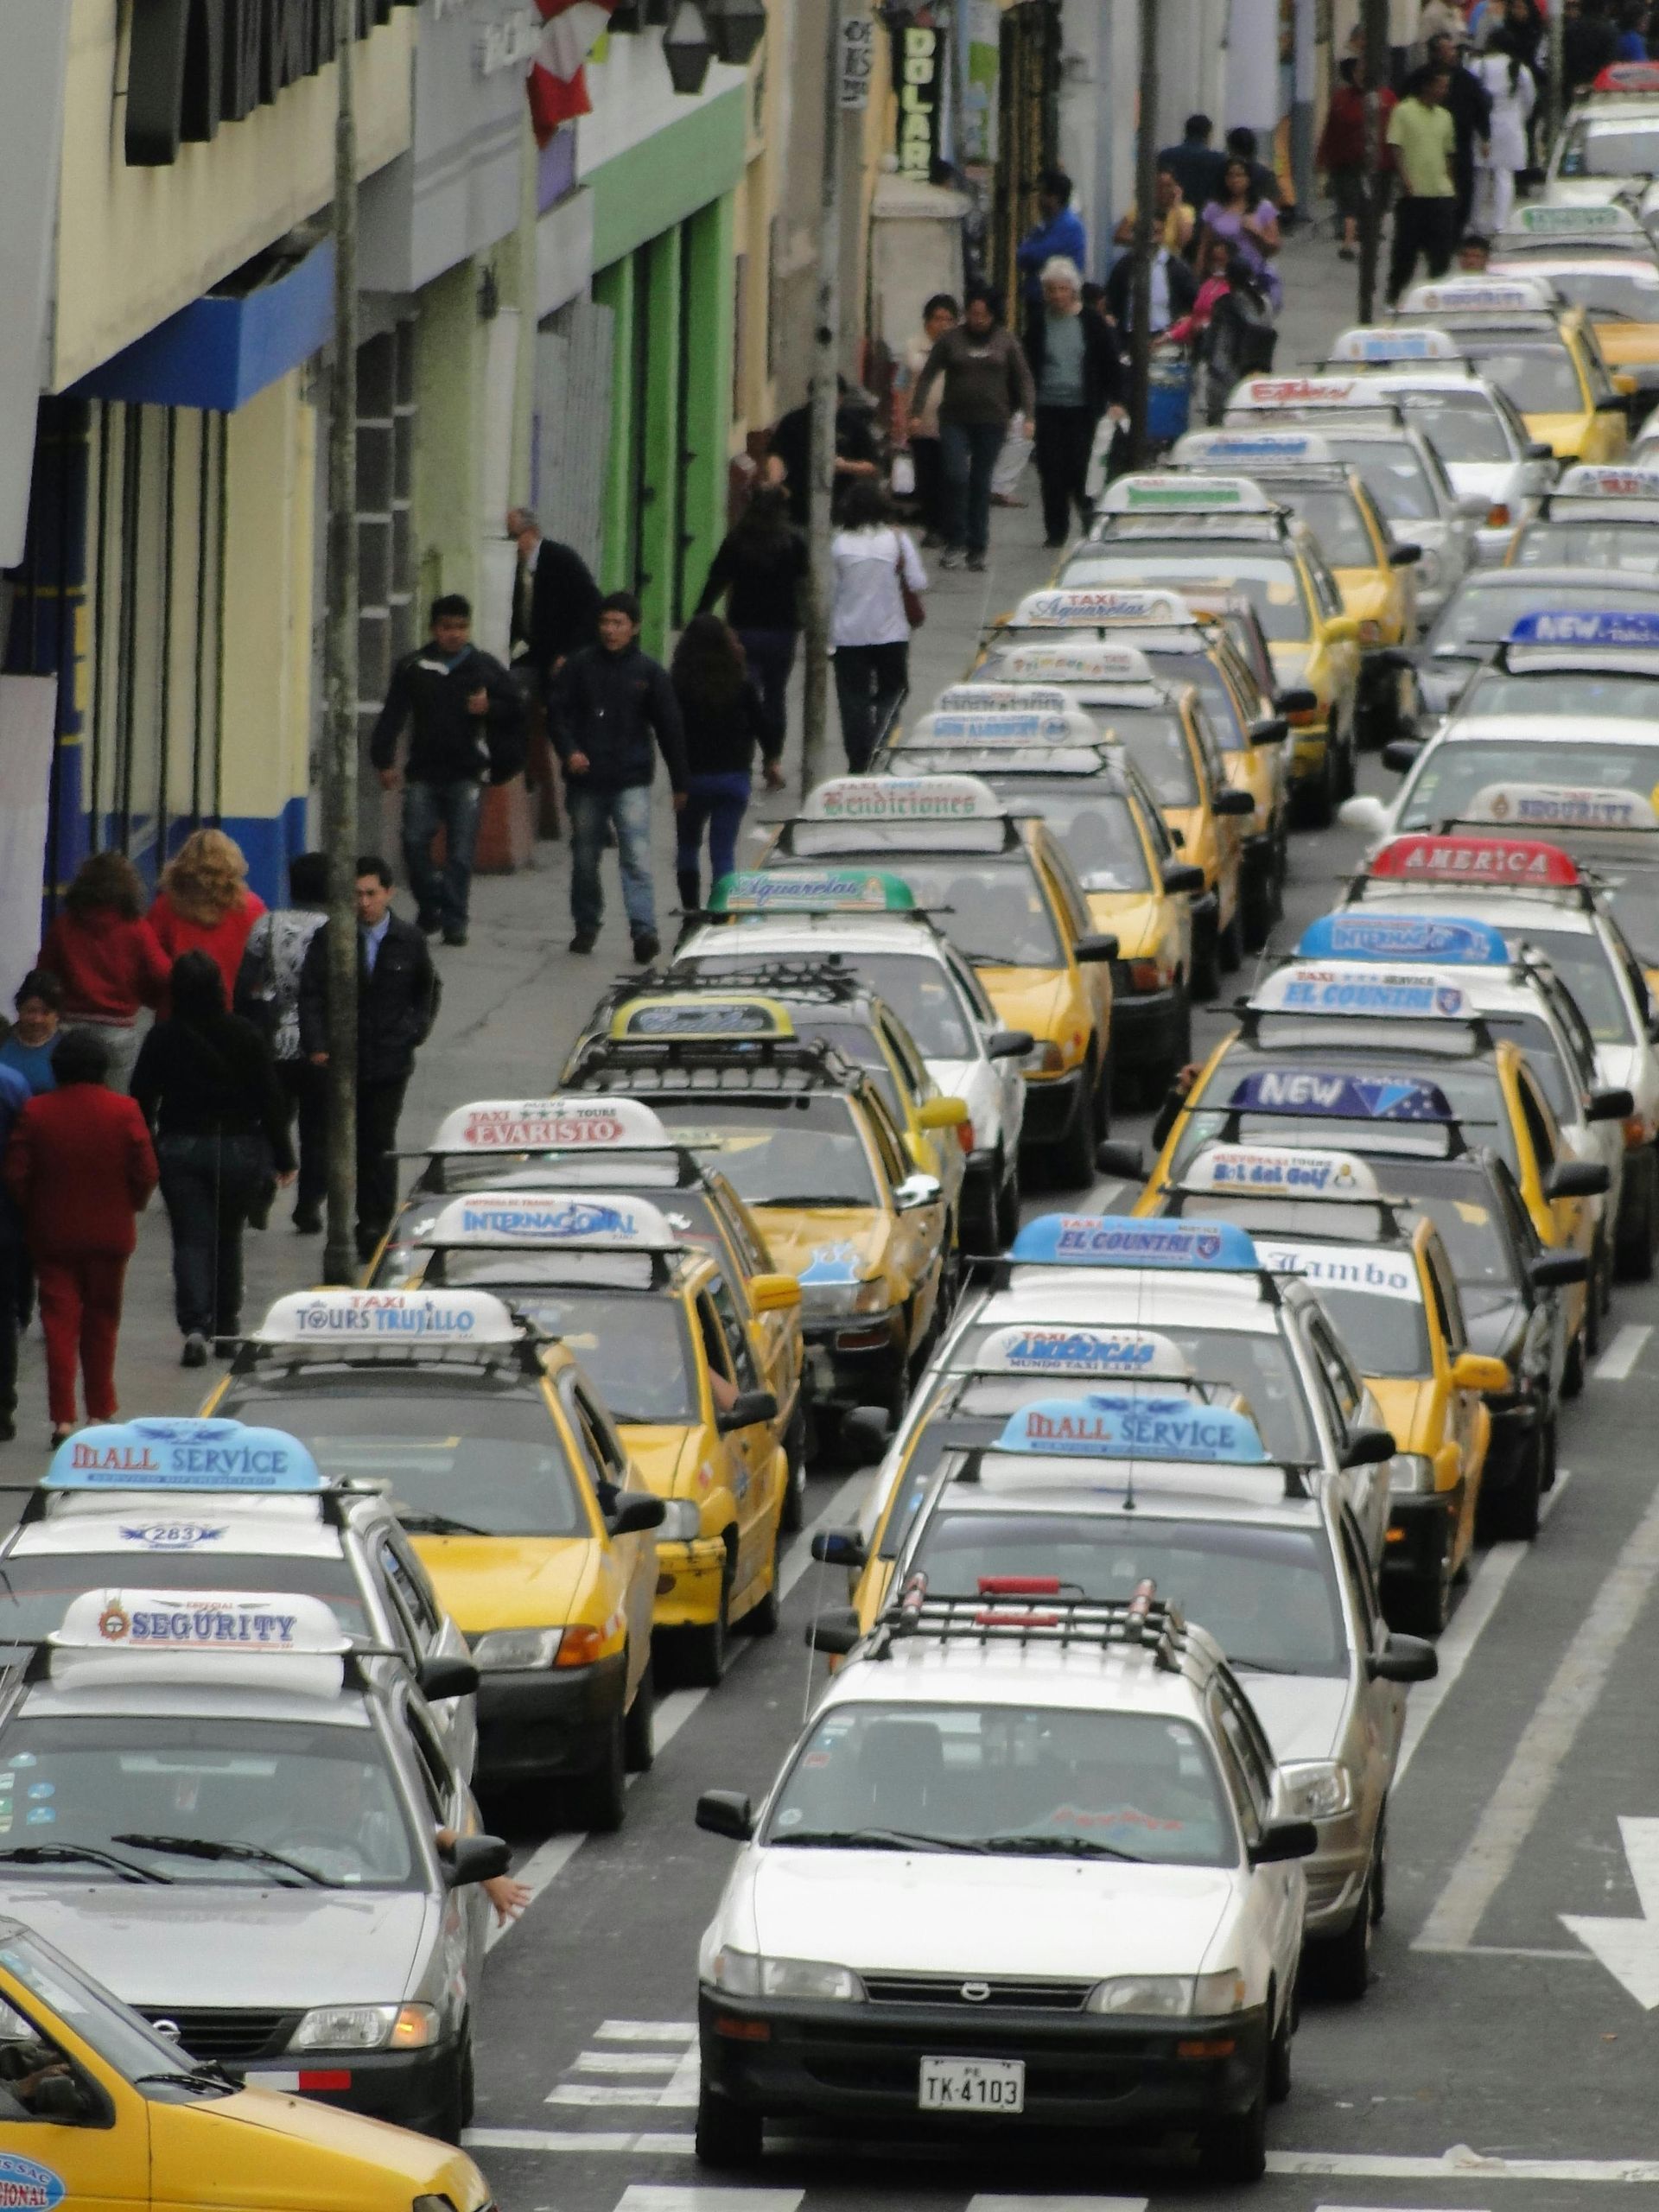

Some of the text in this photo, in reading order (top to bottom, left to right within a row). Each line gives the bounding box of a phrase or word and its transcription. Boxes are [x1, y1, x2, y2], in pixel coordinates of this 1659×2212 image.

[1068, 594, 1120, 607] TAXI
[1536, 614, 1601, 640] NEW
[823, 790, 976, 817] Bendiciones
[1257, 1071, 1344, 1109] NEW
[470, 1109, 617, 1123] TAXI TOURS
[477, 1122, 617, 1146] EVARISTO
[1058, 1230, 1088, 1249] EL
[350, 1295, 407, 1308] TAXI
[296, 1309, 371, 1330] TOURS
[1022, 1332, 1067, 1342] TAXI
[1010, 1358, 1062, 1368] MUNDO
[1121, 1416, 1236, 1450] SERVICE
[71, 1443, 289, 1478] MALL SERVICE
[152, 1527, 197, 1541] 283
[131, 1611, 298, 1642] SEGURITY
[0, 2182, 47, 2207] IONAL
